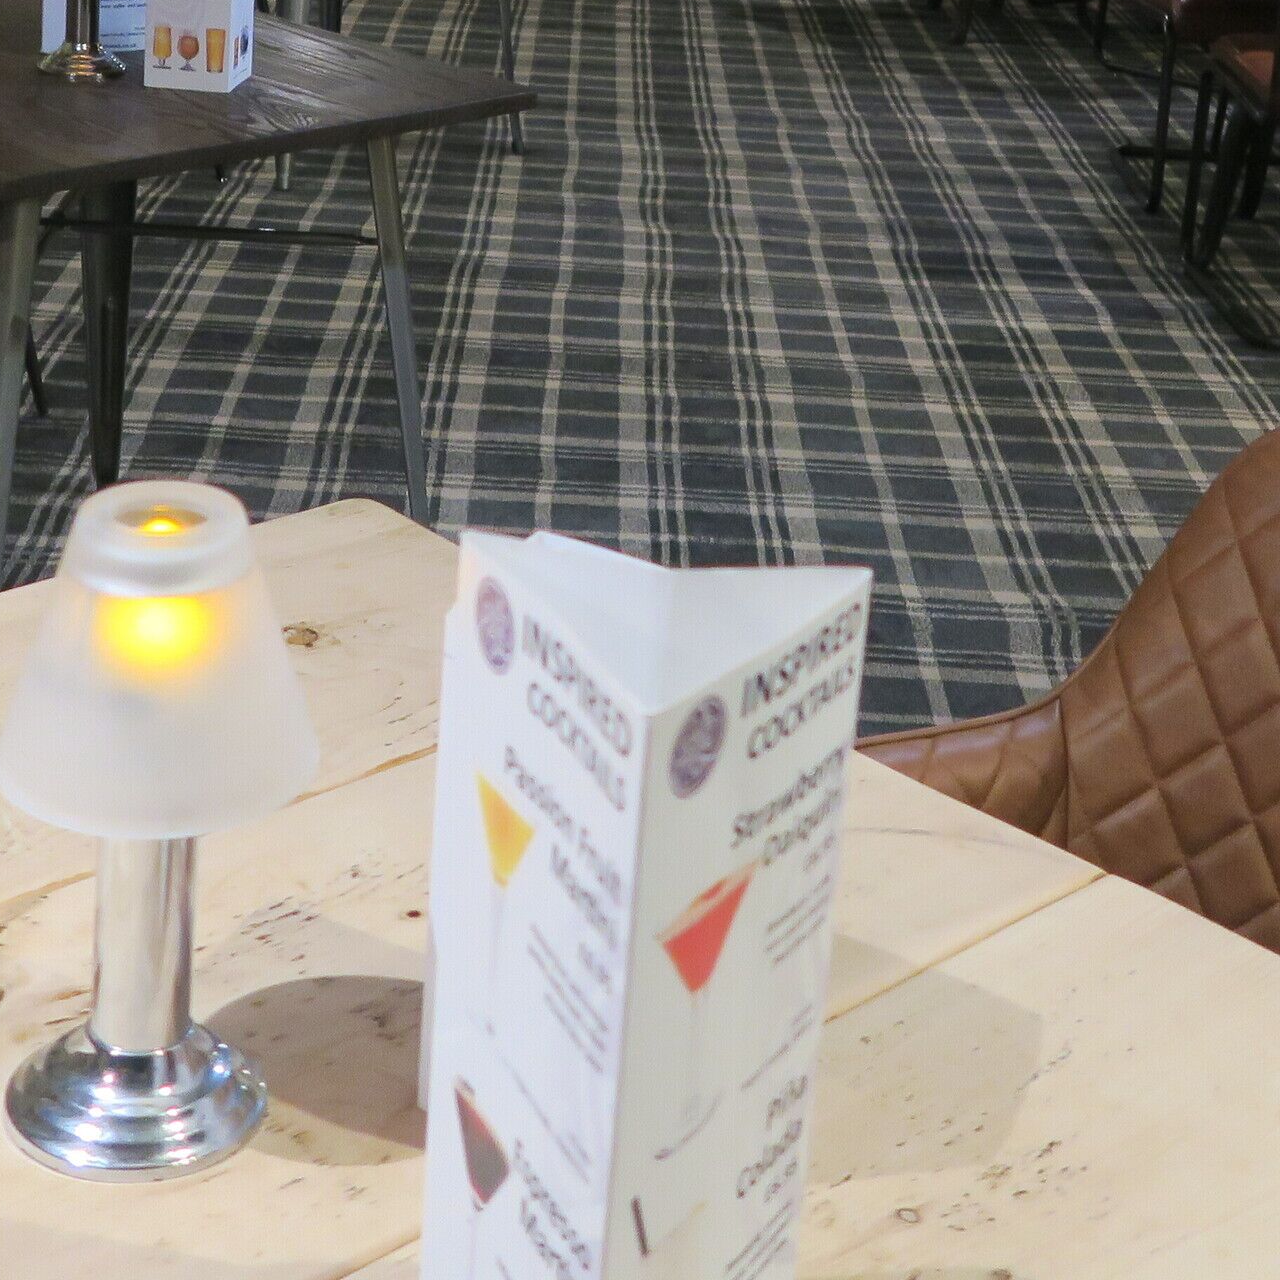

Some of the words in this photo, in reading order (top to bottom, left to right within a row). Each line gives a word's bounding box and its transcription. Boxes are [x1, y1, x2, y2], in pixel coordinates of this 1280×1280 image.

[523, 615, 634, 757] INSPIRED
[741, 601, 862, 719] INSPIRED
[746, 655, 857, 760] COCKTAILS
[526, 681, 626, 812] COCKTAILS
[730, 745, 846, 850] Strawberry
